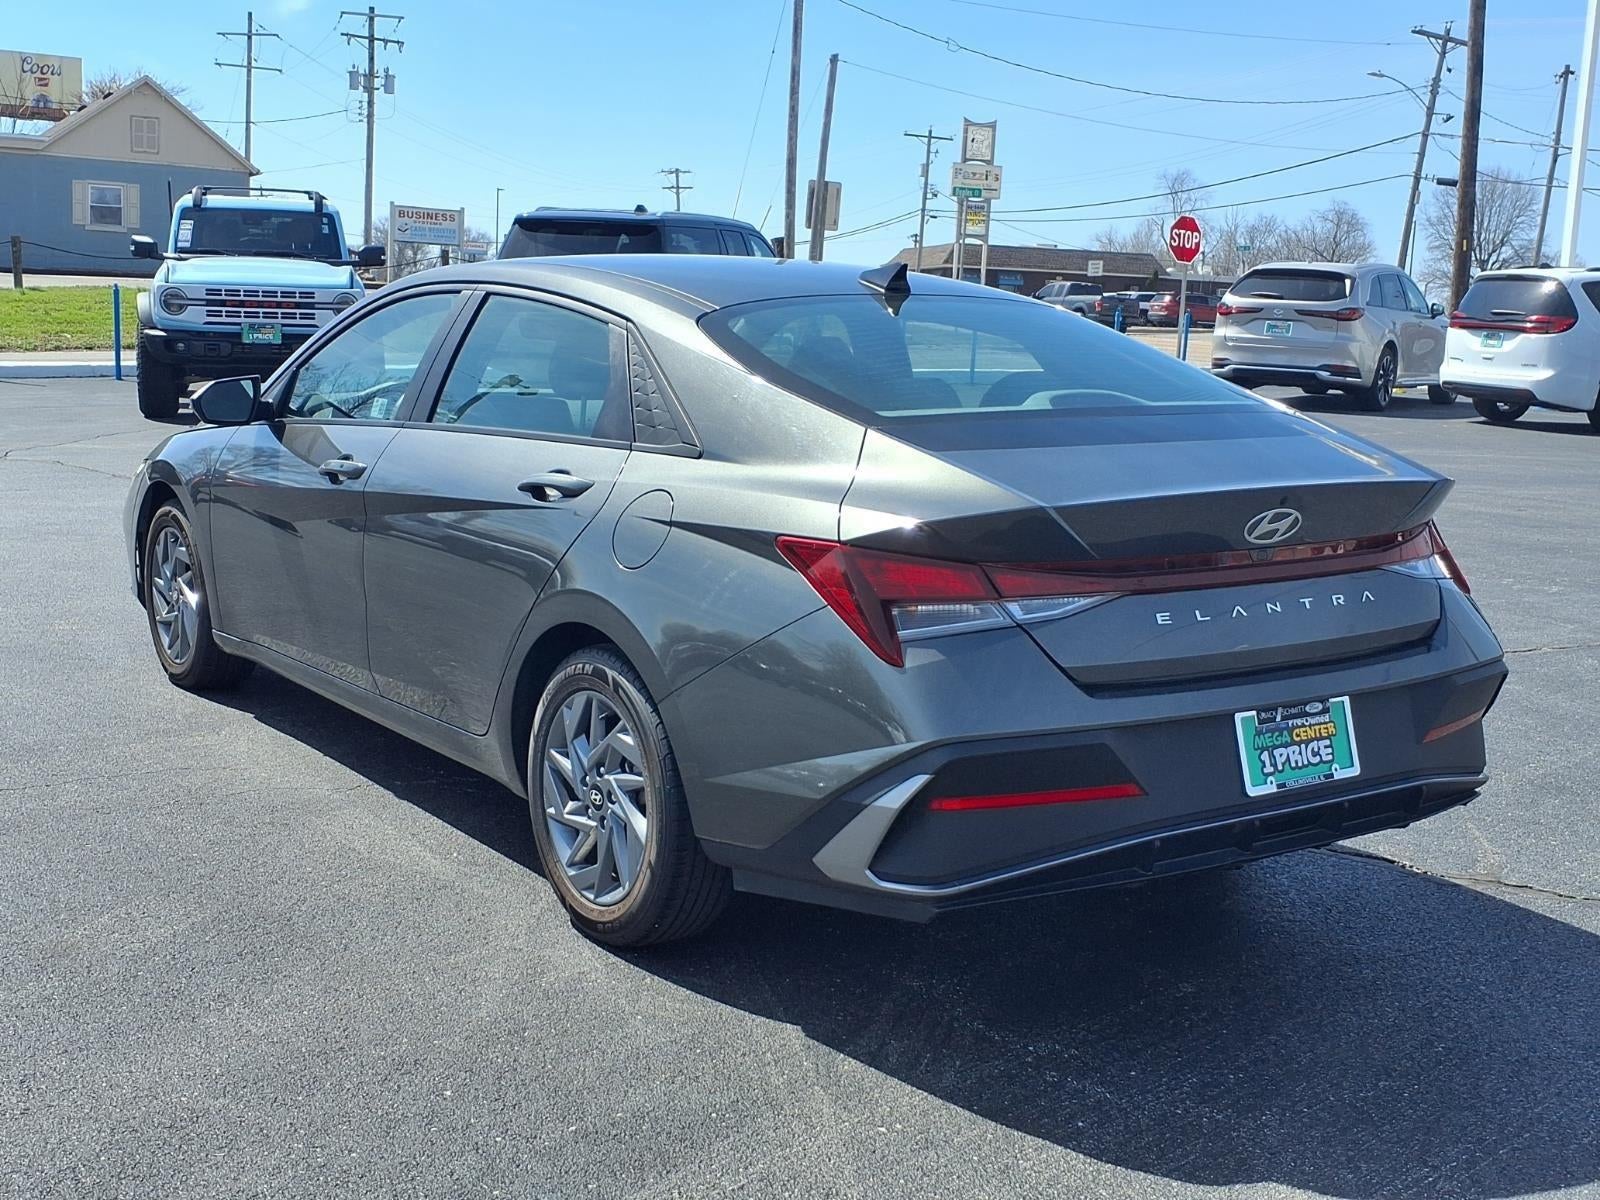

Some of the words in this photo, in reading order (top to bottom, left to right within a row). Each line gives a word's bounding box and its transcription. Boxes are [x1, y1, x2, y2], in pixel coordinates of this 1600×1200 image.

[21, 56, 62, 76] Coors
[398, 209, 456, 222] BUSINESS
[1171, 229, 1200, 249] STOP
[225, 299, 296, 308] FORD
[1155, 591, 1375, 625] ELANTRA
[1281, 705, 1305, 717] SCHMITT
[1254, 730, 1291, 749] MEGA
[1292, 722, 1336, 742] CENTER
